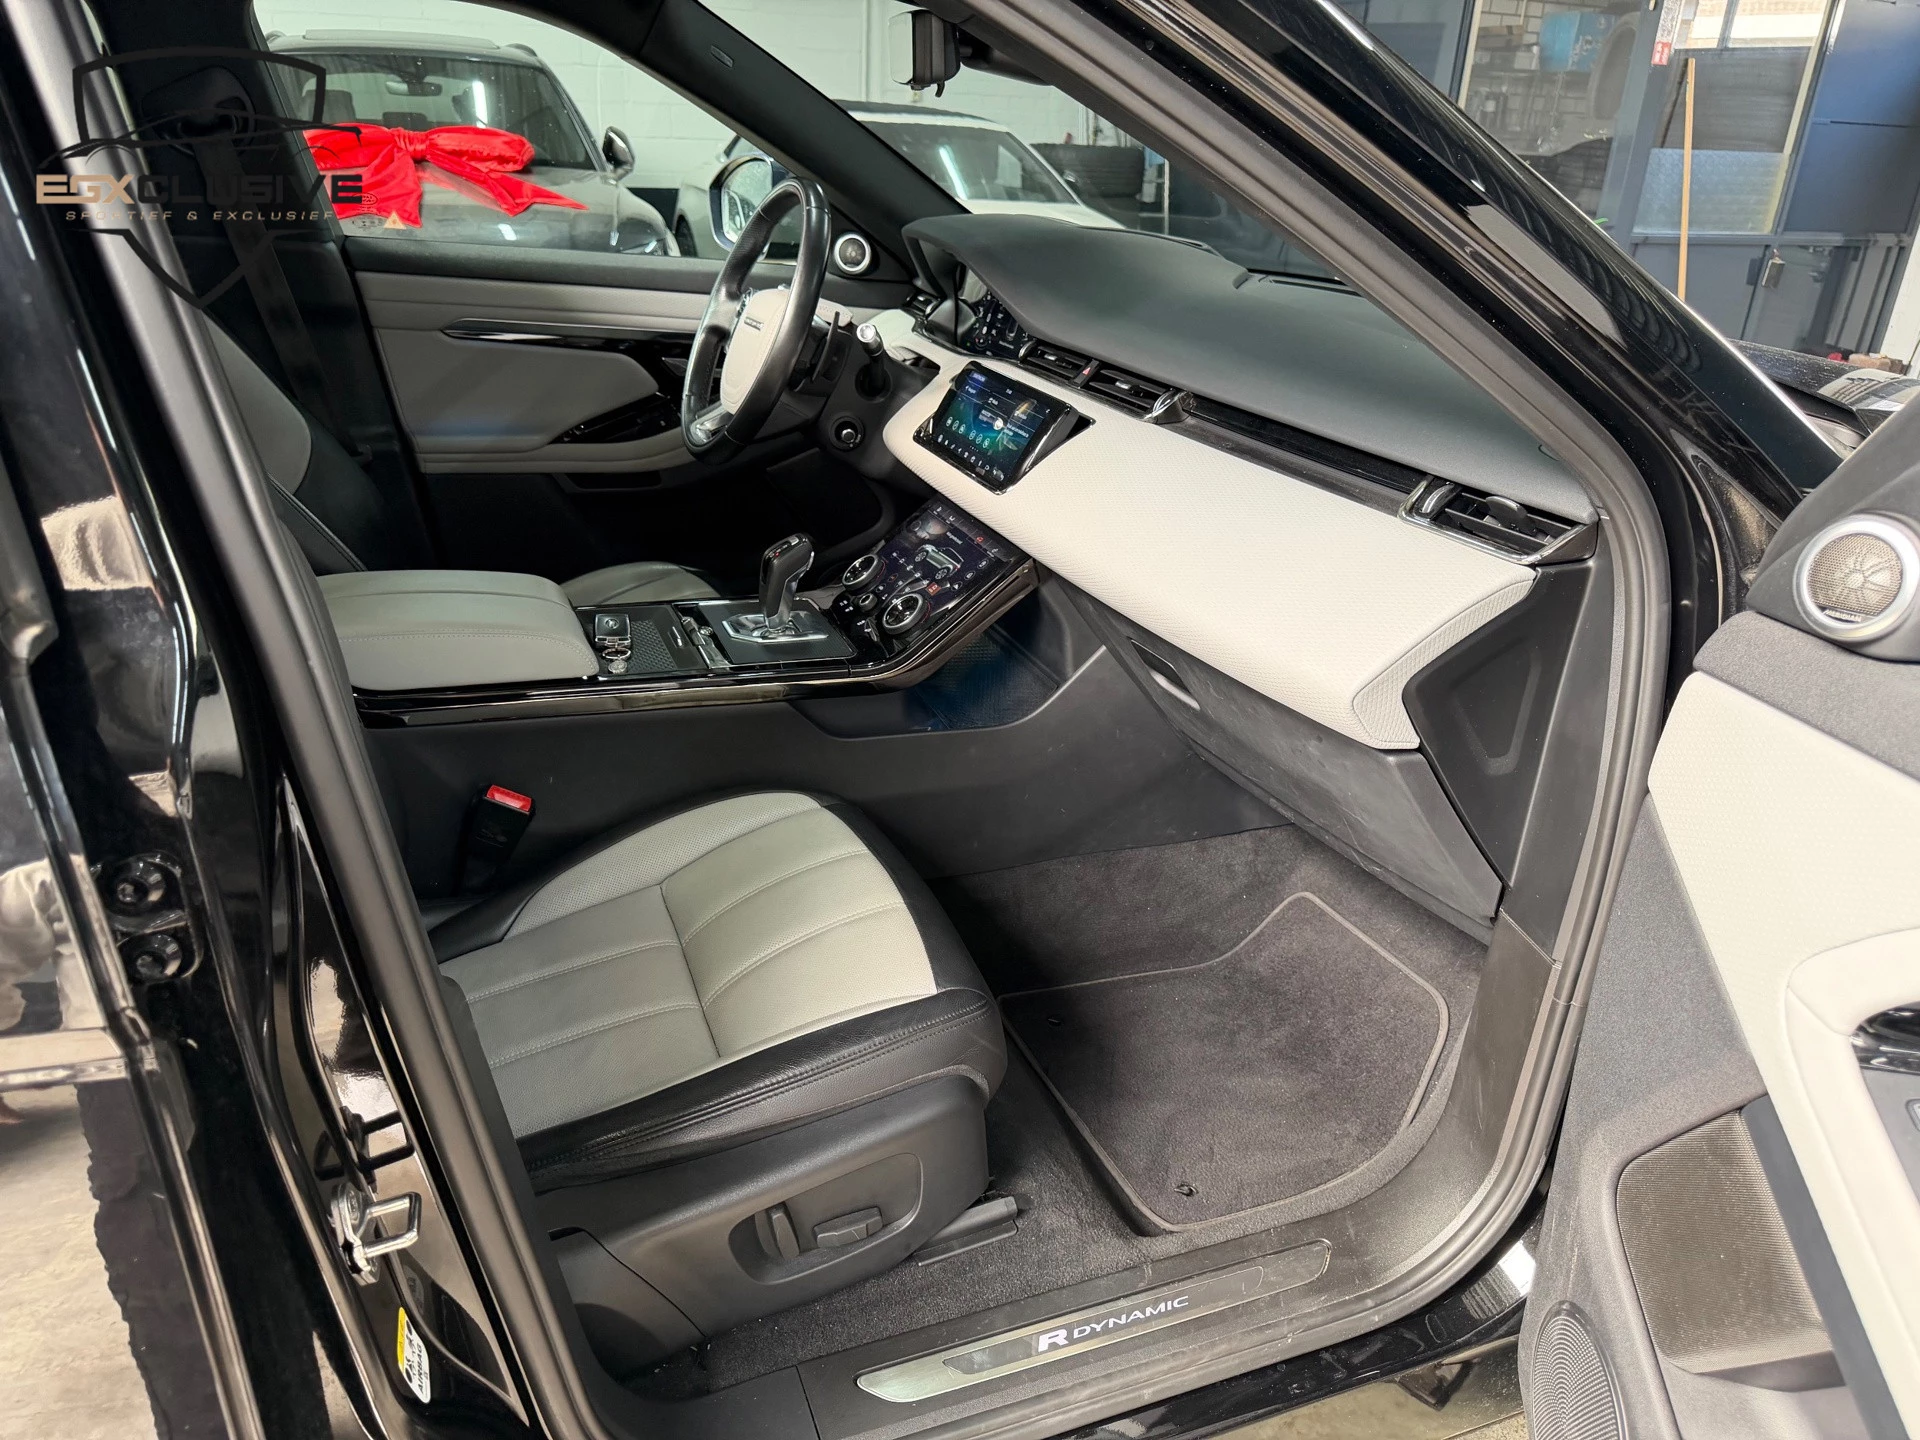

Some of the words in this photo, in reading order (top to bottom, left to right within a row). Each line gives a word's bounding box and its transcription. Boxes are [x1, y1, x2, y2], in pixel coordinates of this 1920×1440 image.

[1037, 1328, 1069, 1353] R
[1073, 1295, 1189, 1339] DYNAMIC
[416, 1342, 424, 1395] AIRBAG
